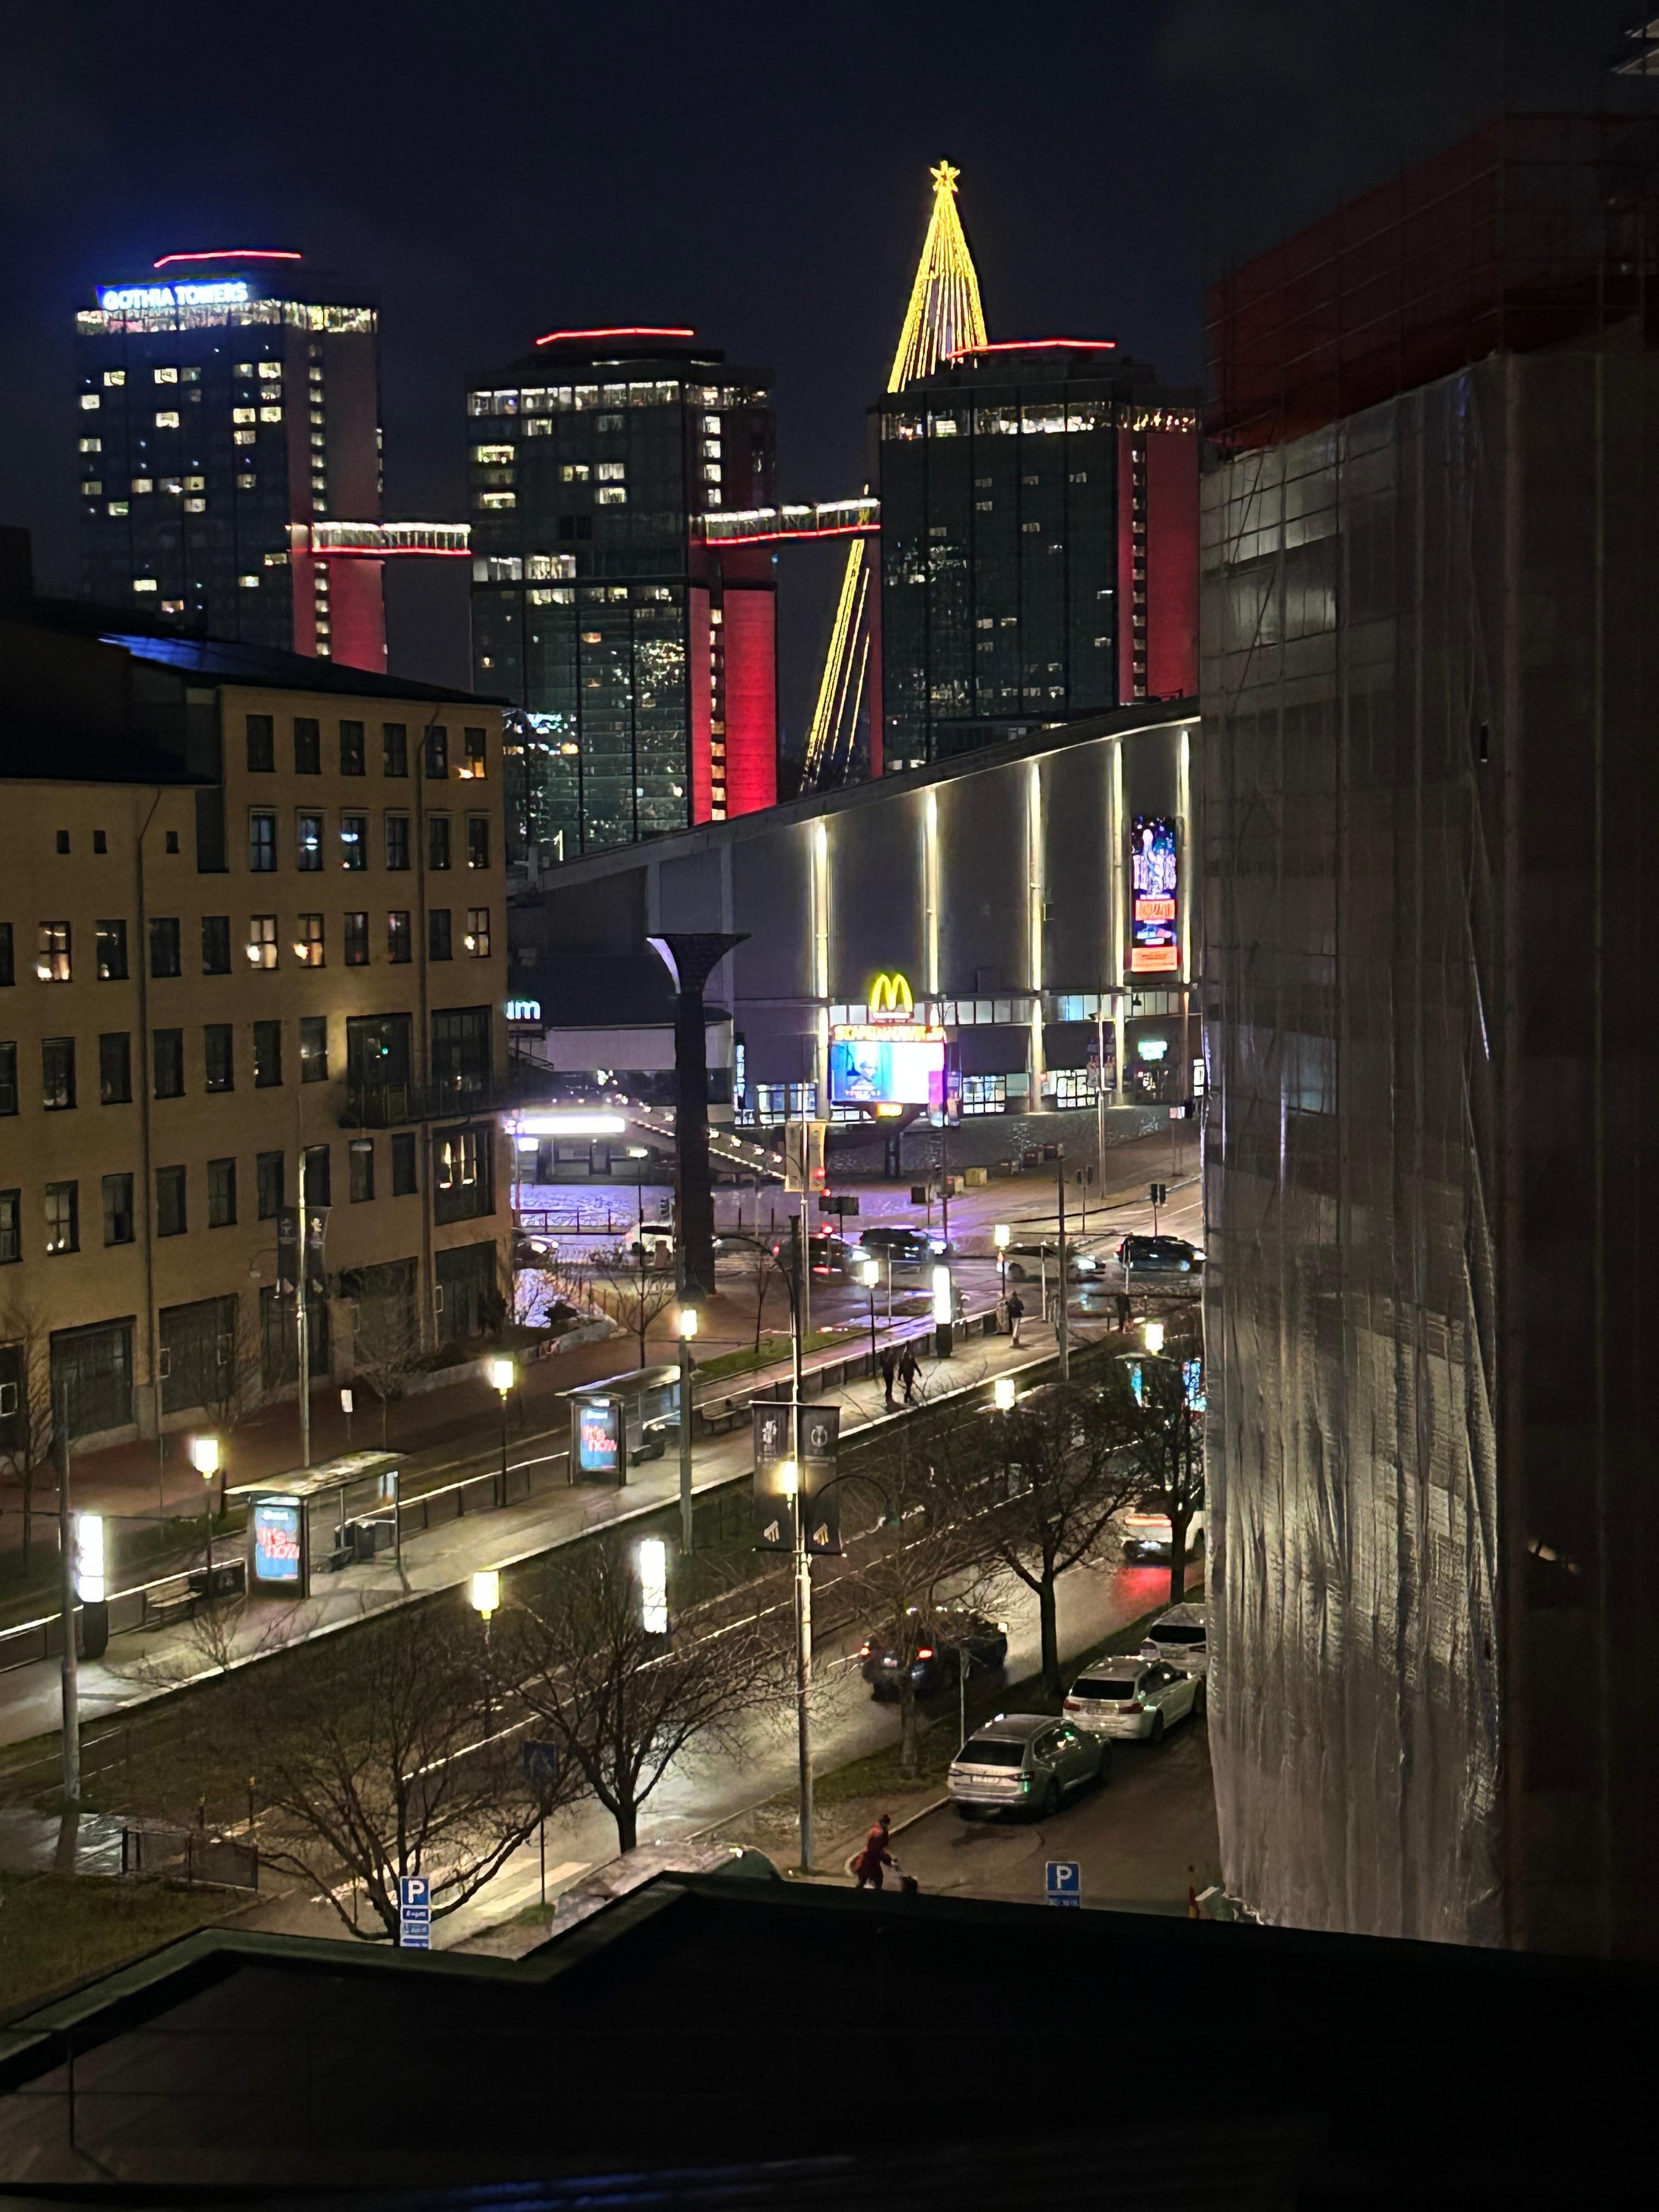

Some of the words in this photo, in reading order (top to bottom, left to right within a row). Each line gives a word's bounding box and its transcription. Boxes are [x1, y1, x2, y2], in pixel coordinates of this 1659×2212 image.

[103, 288, 174, 311] GOTHIA
[1057, 1865, 1072, 1889] P
[408, 1880, 425, 1904] P
